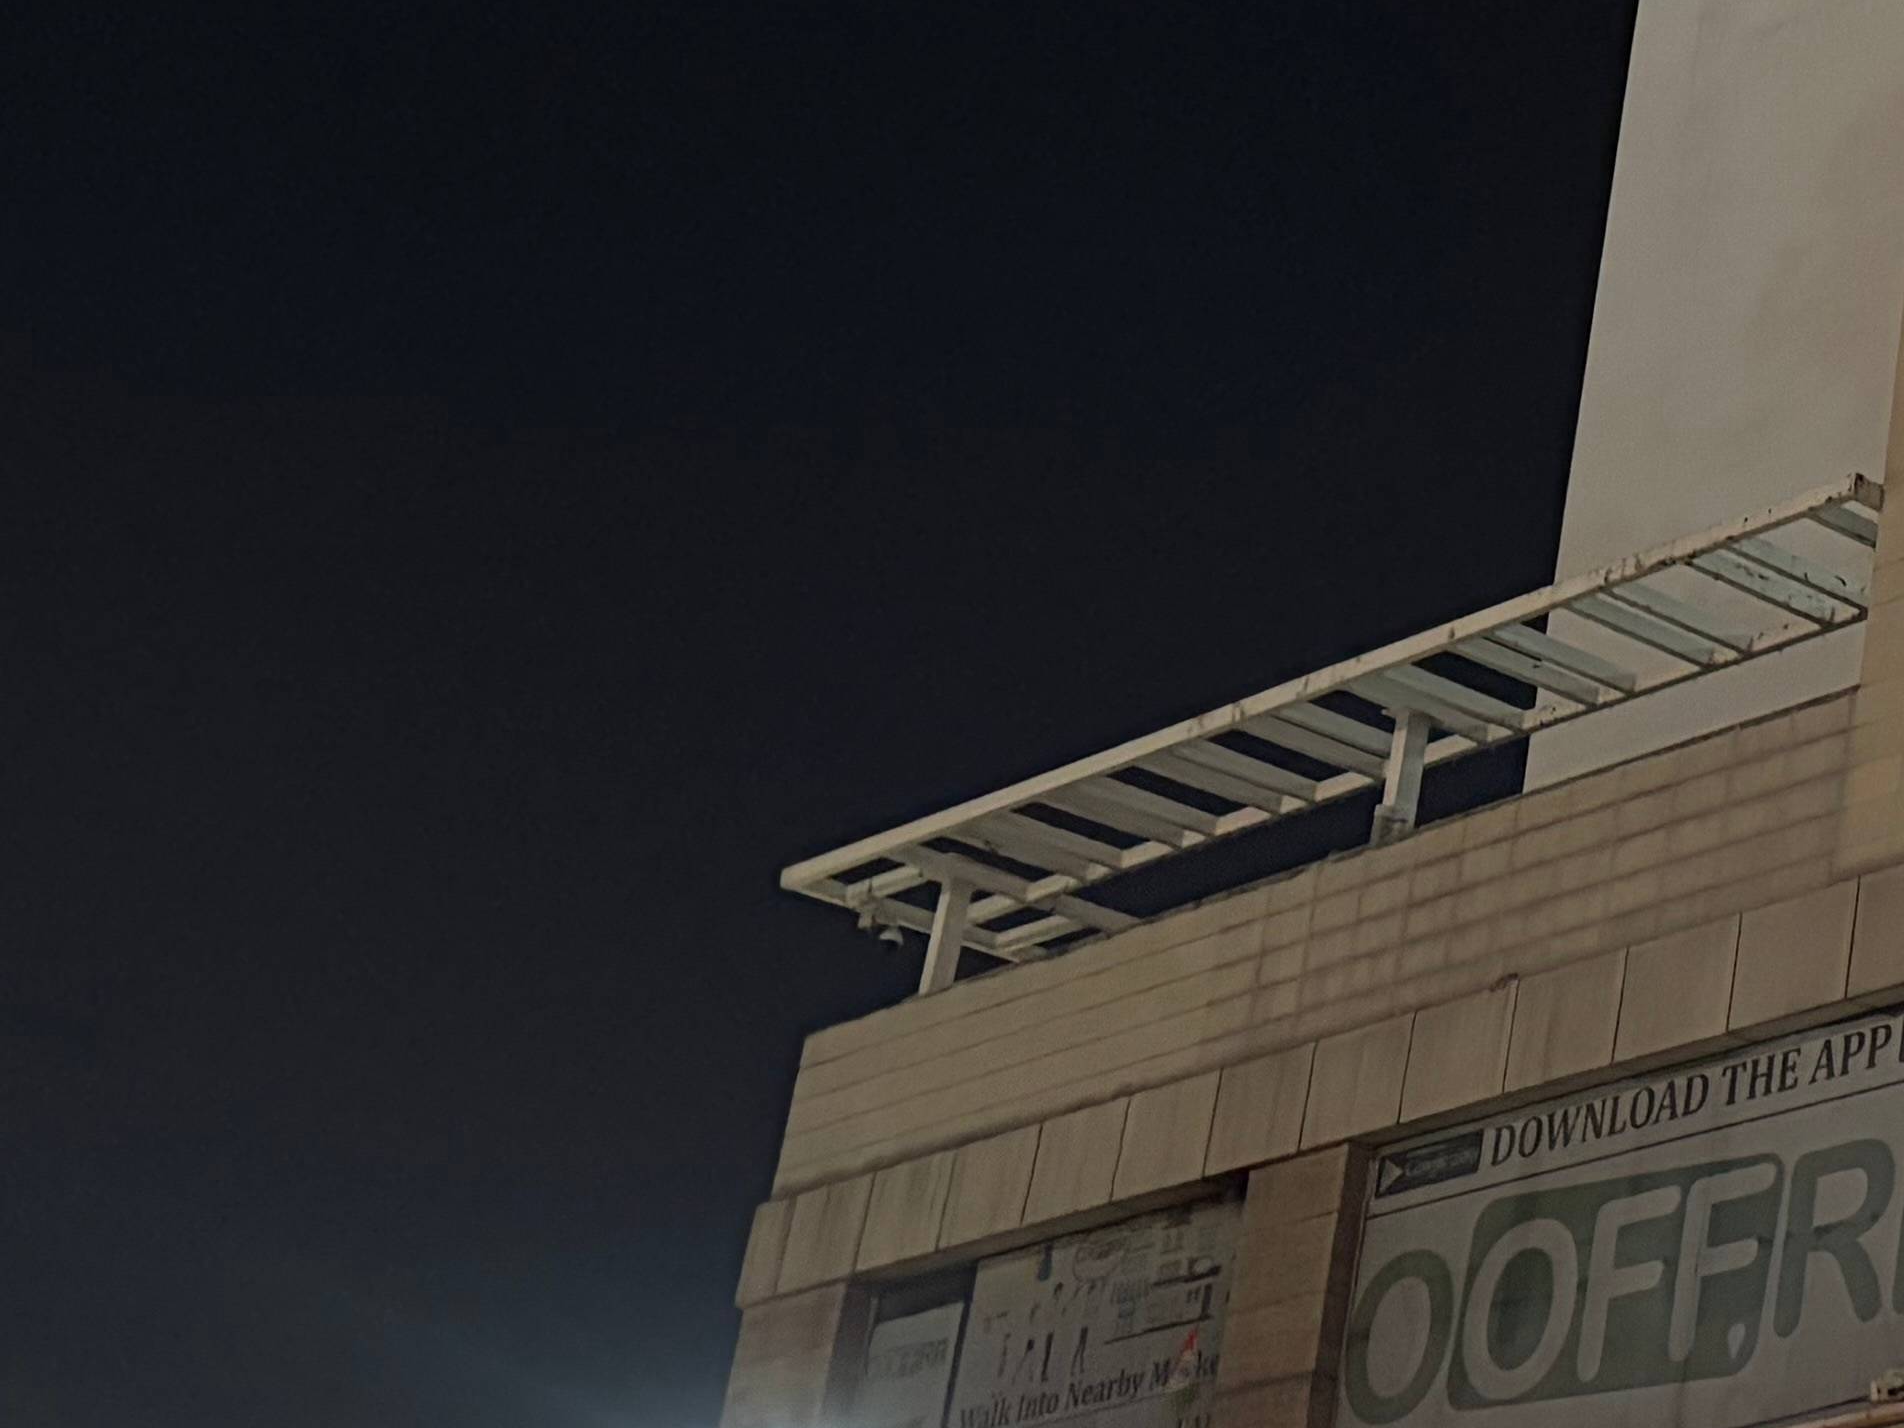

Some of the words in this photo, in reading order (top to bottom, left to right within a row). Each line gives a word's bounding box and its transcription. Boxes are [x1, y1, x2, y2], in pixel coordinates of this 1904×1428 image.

[1490, 1072, 1709, 1167] DOWNLOAD
[1722, 1048, 1801, 1106] THE
[1808, 1023, 1893, 1085] APP
[1064, 1368, 1145, 1410] Nearby
